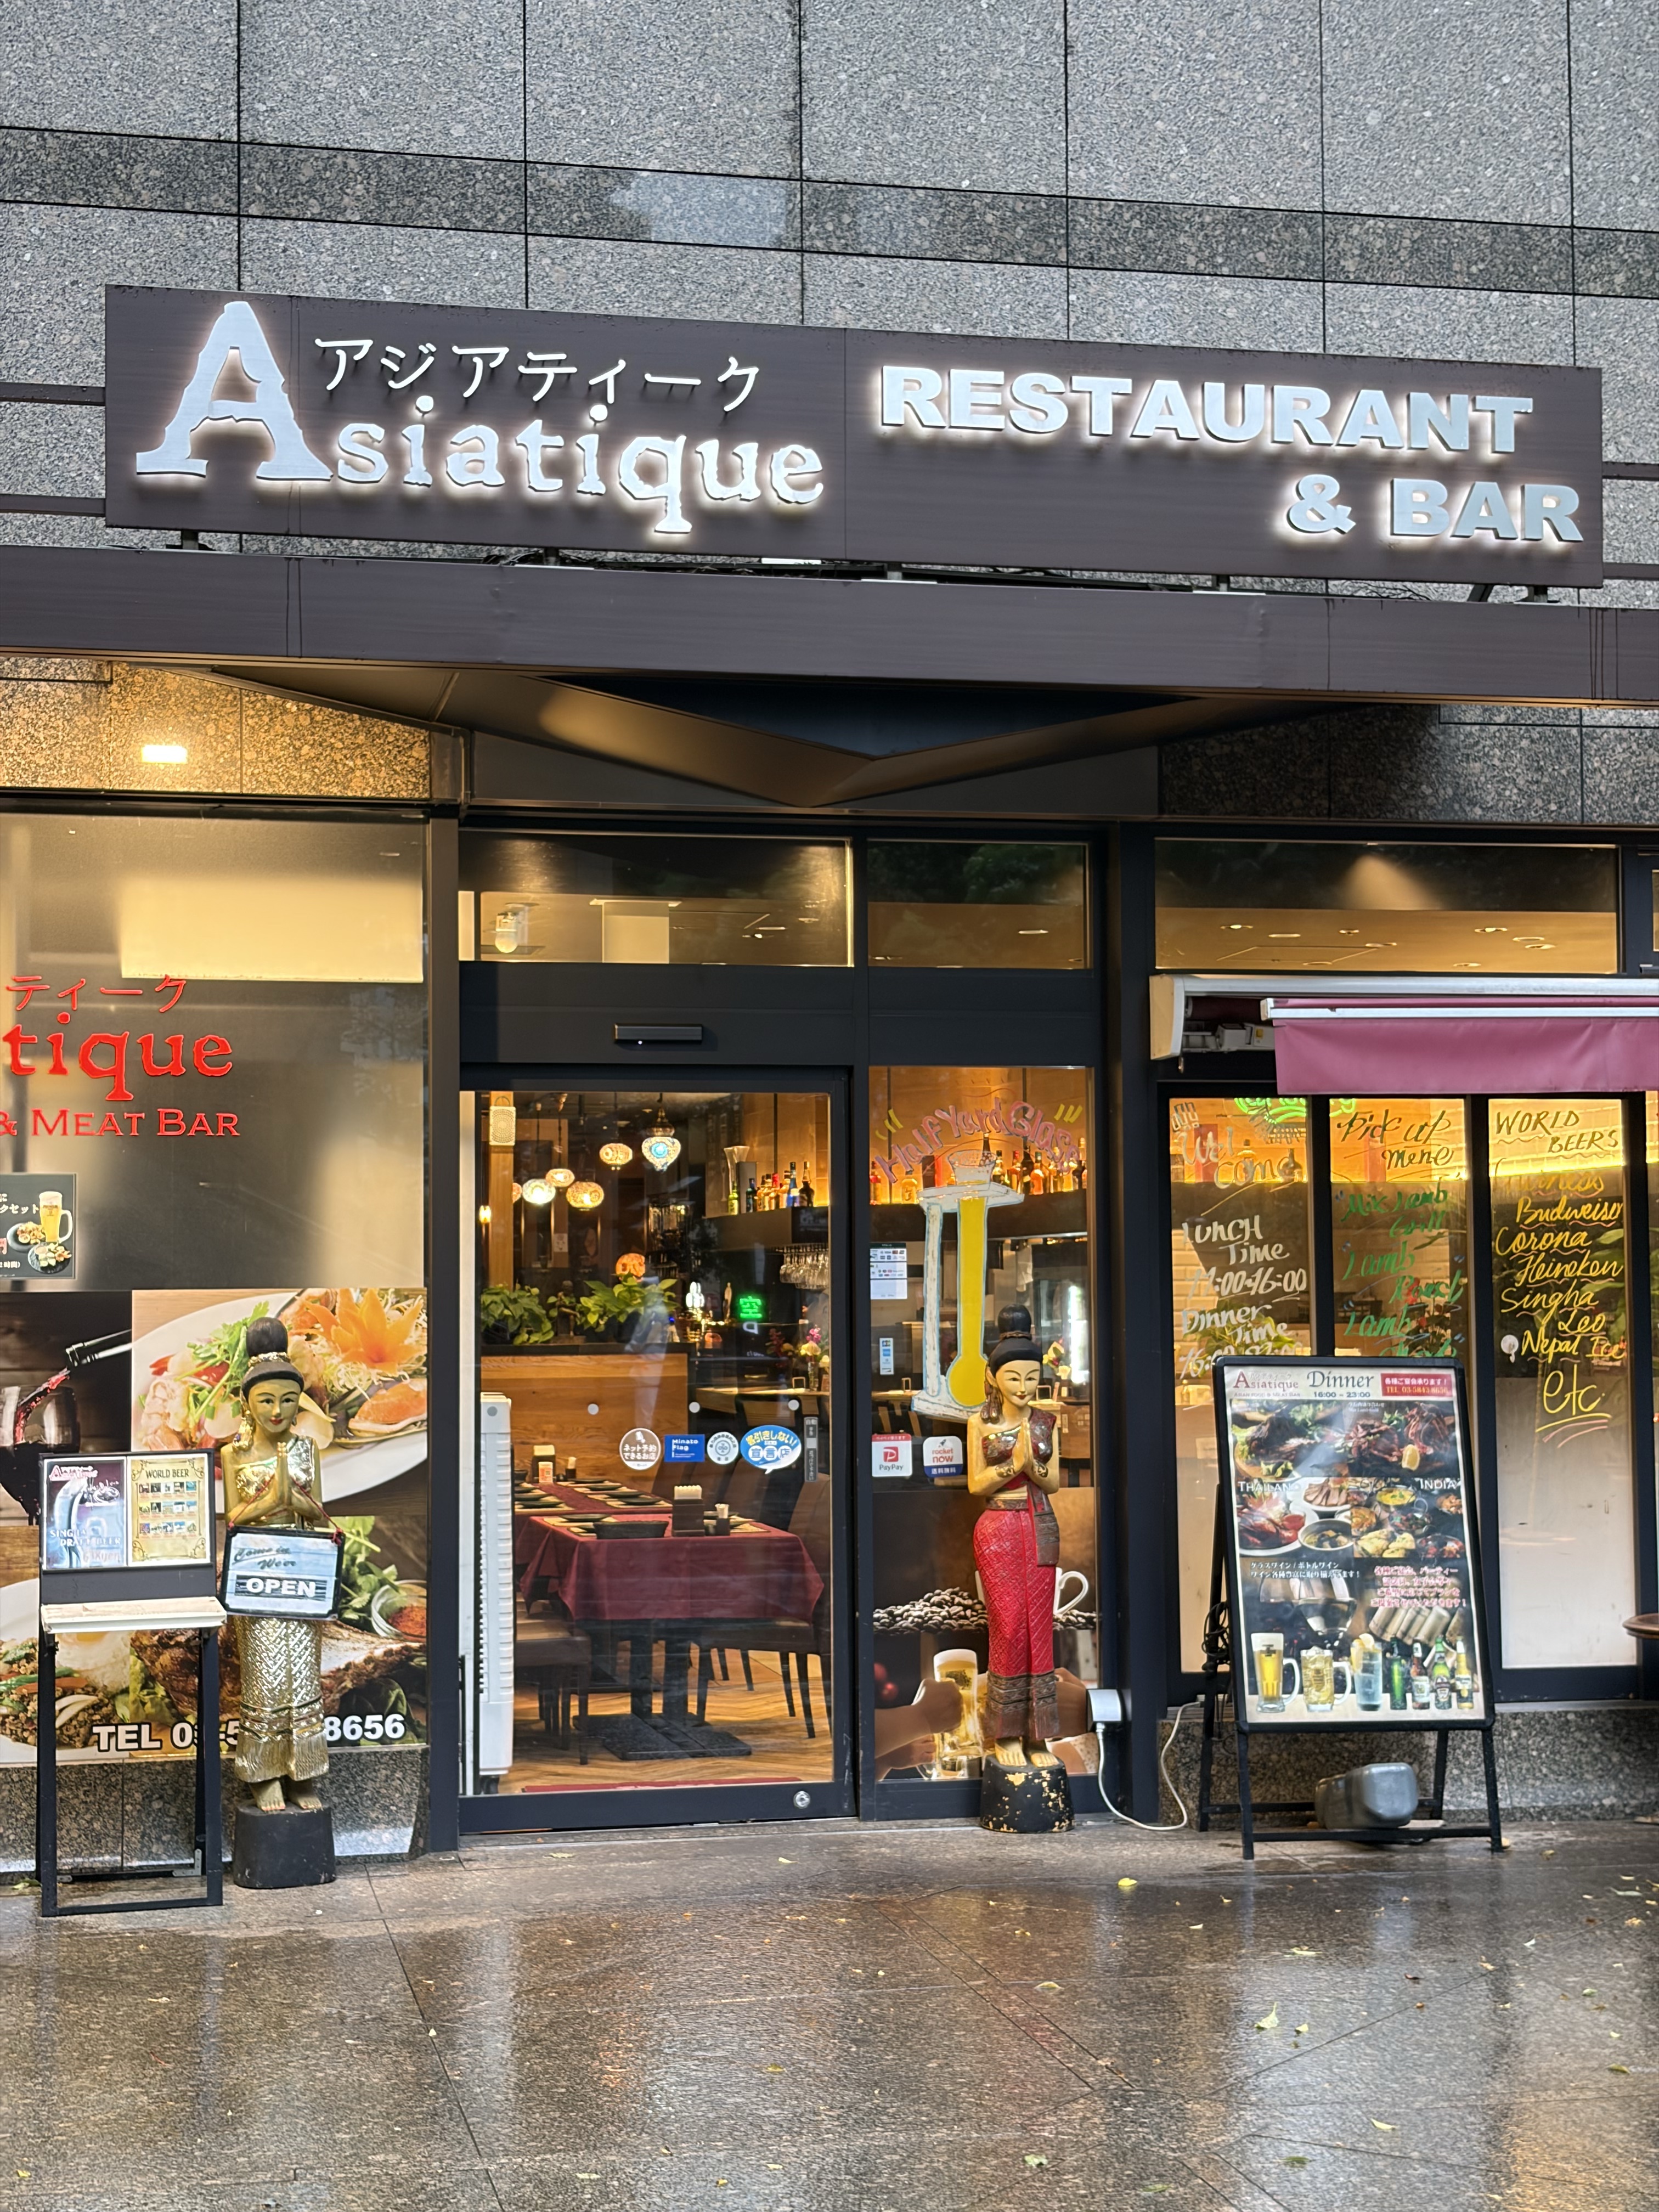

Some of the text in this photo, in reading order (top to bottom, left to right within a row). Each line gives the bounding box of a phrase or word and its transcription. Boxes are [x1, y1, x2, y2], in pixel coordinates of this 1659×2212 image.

[314, 338, 760, 411] アジアティーク
[136, 300, 824, 533] Asiatique
[881, 365, 1533, 454] RESTAURANT
[1286, 474, 1583, 543] & BAR
[7, 974, 186, 1013] ティーク
[2, 1012, 233, 1101] tique
[31, 1108, 145, 1136] MEAT
[157, 1108, 240, 1136] BAR
[1496, 1110, 1579, 1136] WORLD
[874, 1115, 944, 1183] Half
[934, 1097, 1008, 1139] Yard
[1548, 1129, 1618, 1153] BEERS
[1495, 1227, 1593, 1256] Corona
[1515, 1251, 1624, 1286] Heineken
[1501, 1279, 1599, 1328] Singha
[1182, 1304, 1272, 1334] Dinner
[1558, 1309, 1606, 1333] Leo
[1521, 1325, 1580, 1364] Nepal
[1233, 1370, 1374, 1391] Asiatique Dinner
[623, 1443, 657, 1452] ネット予約
[146, 1468, 189, 1479] WORLD BEER
[1238, 1481, 1301, 1492] THAILAN
[246, 1578, 316, 1598] OPEN
[93, 1724, 161, 1751] TEL
